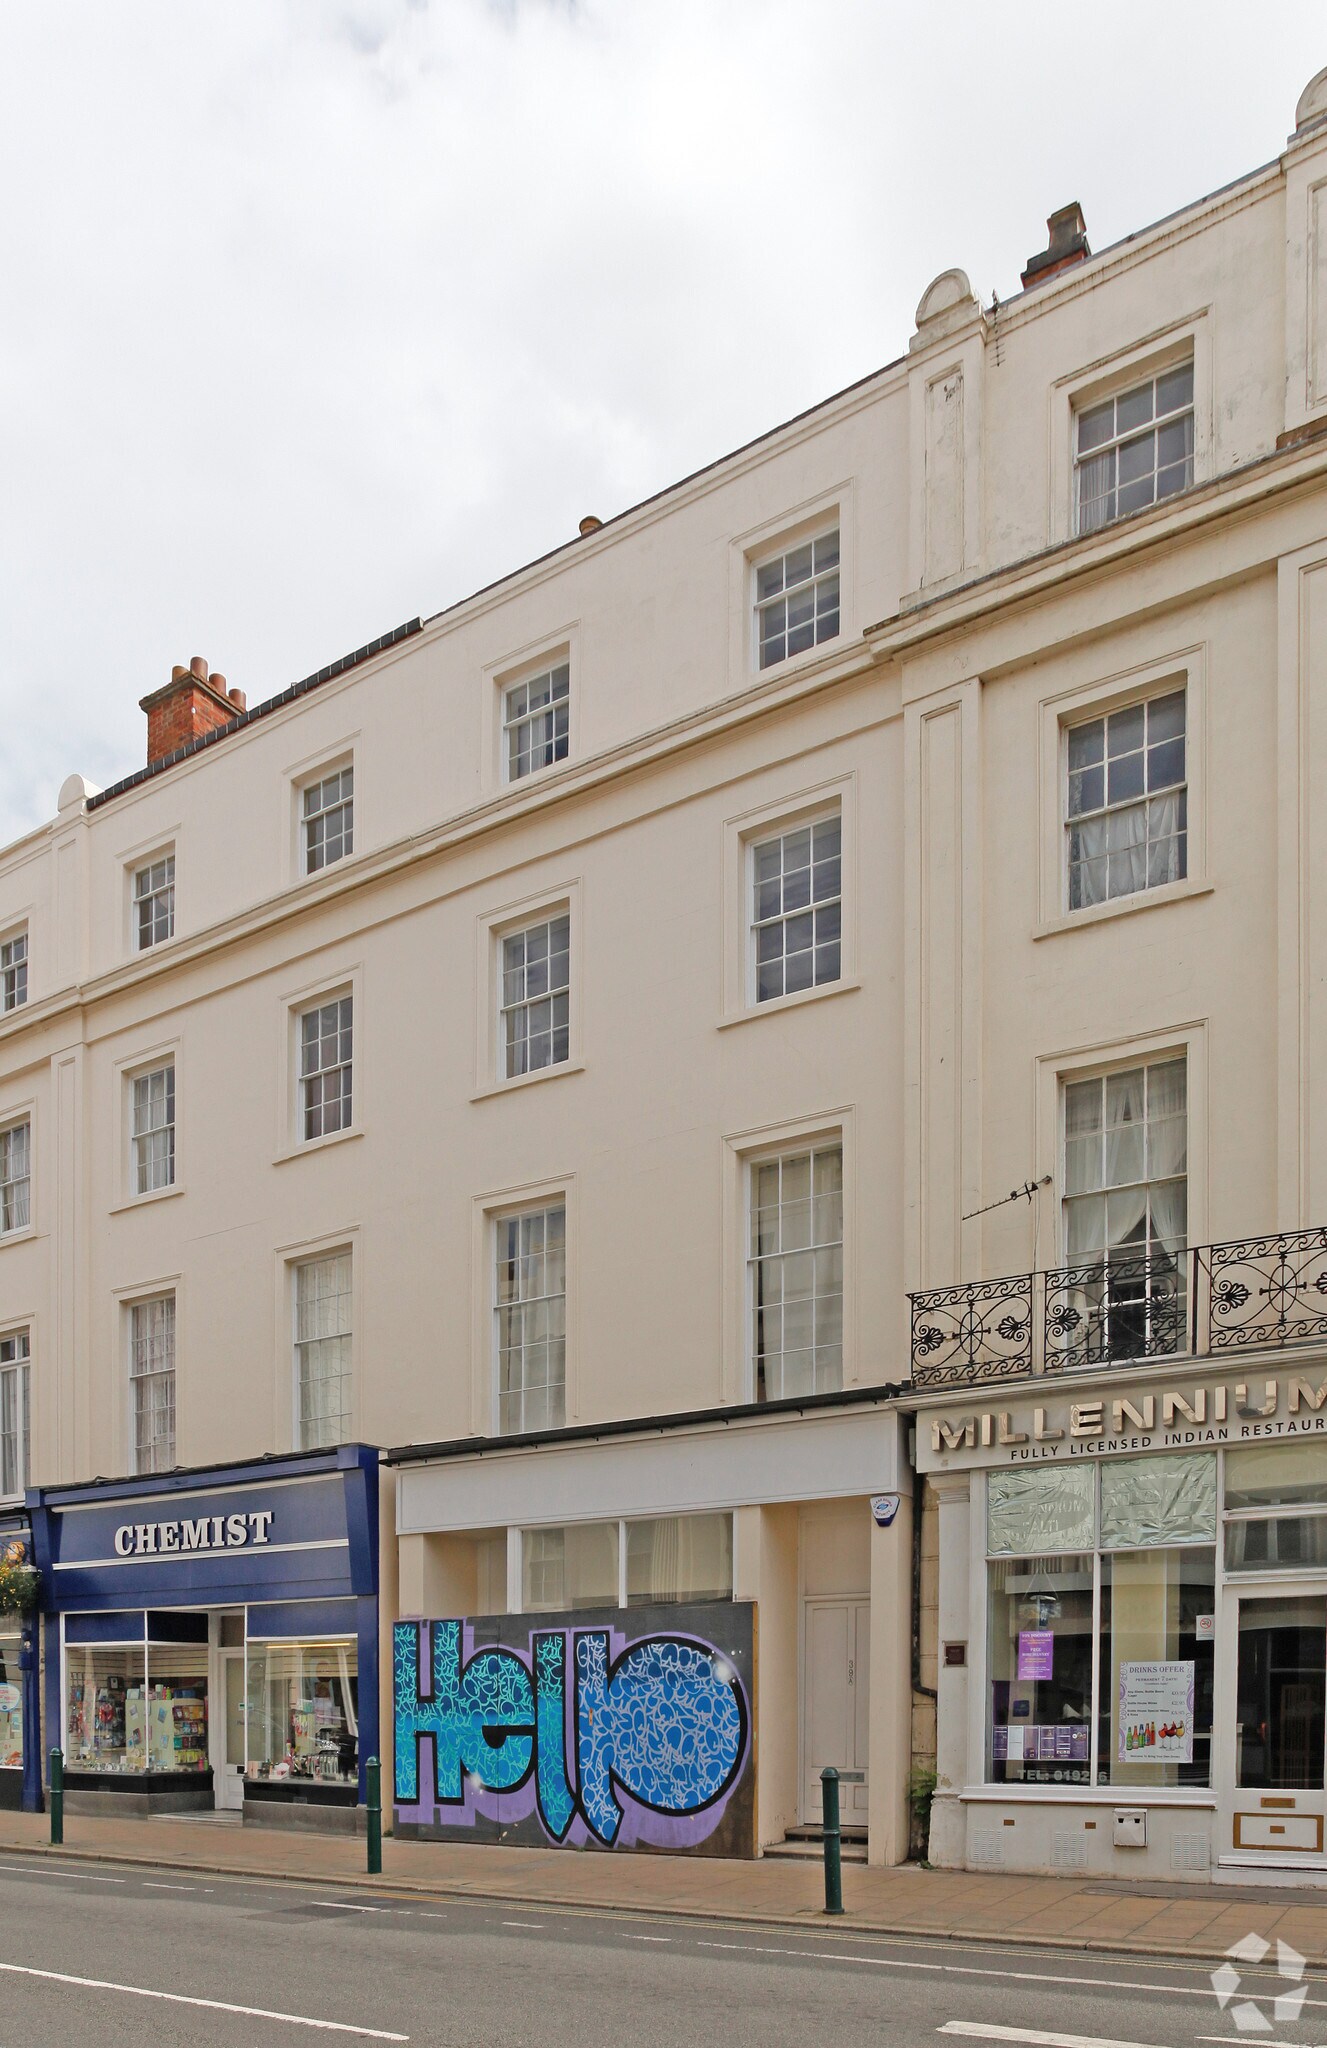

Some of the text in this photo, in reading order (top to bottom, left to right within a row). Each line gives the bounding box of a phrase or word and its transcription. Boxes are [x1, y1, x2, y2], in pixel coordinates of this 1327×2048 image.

[931, 1376, 1327, 1451] MILLENNIUM
[1010, 1418, 1325, 1460] FULLY LICENSED INDIAN RESTAUR
[114, 1511, 273, 1556] CHEMIST
[1129, 1665, 1185, 1674] DRINKS OFFER
[1016, 1769, 1049, 1781] TEL:
